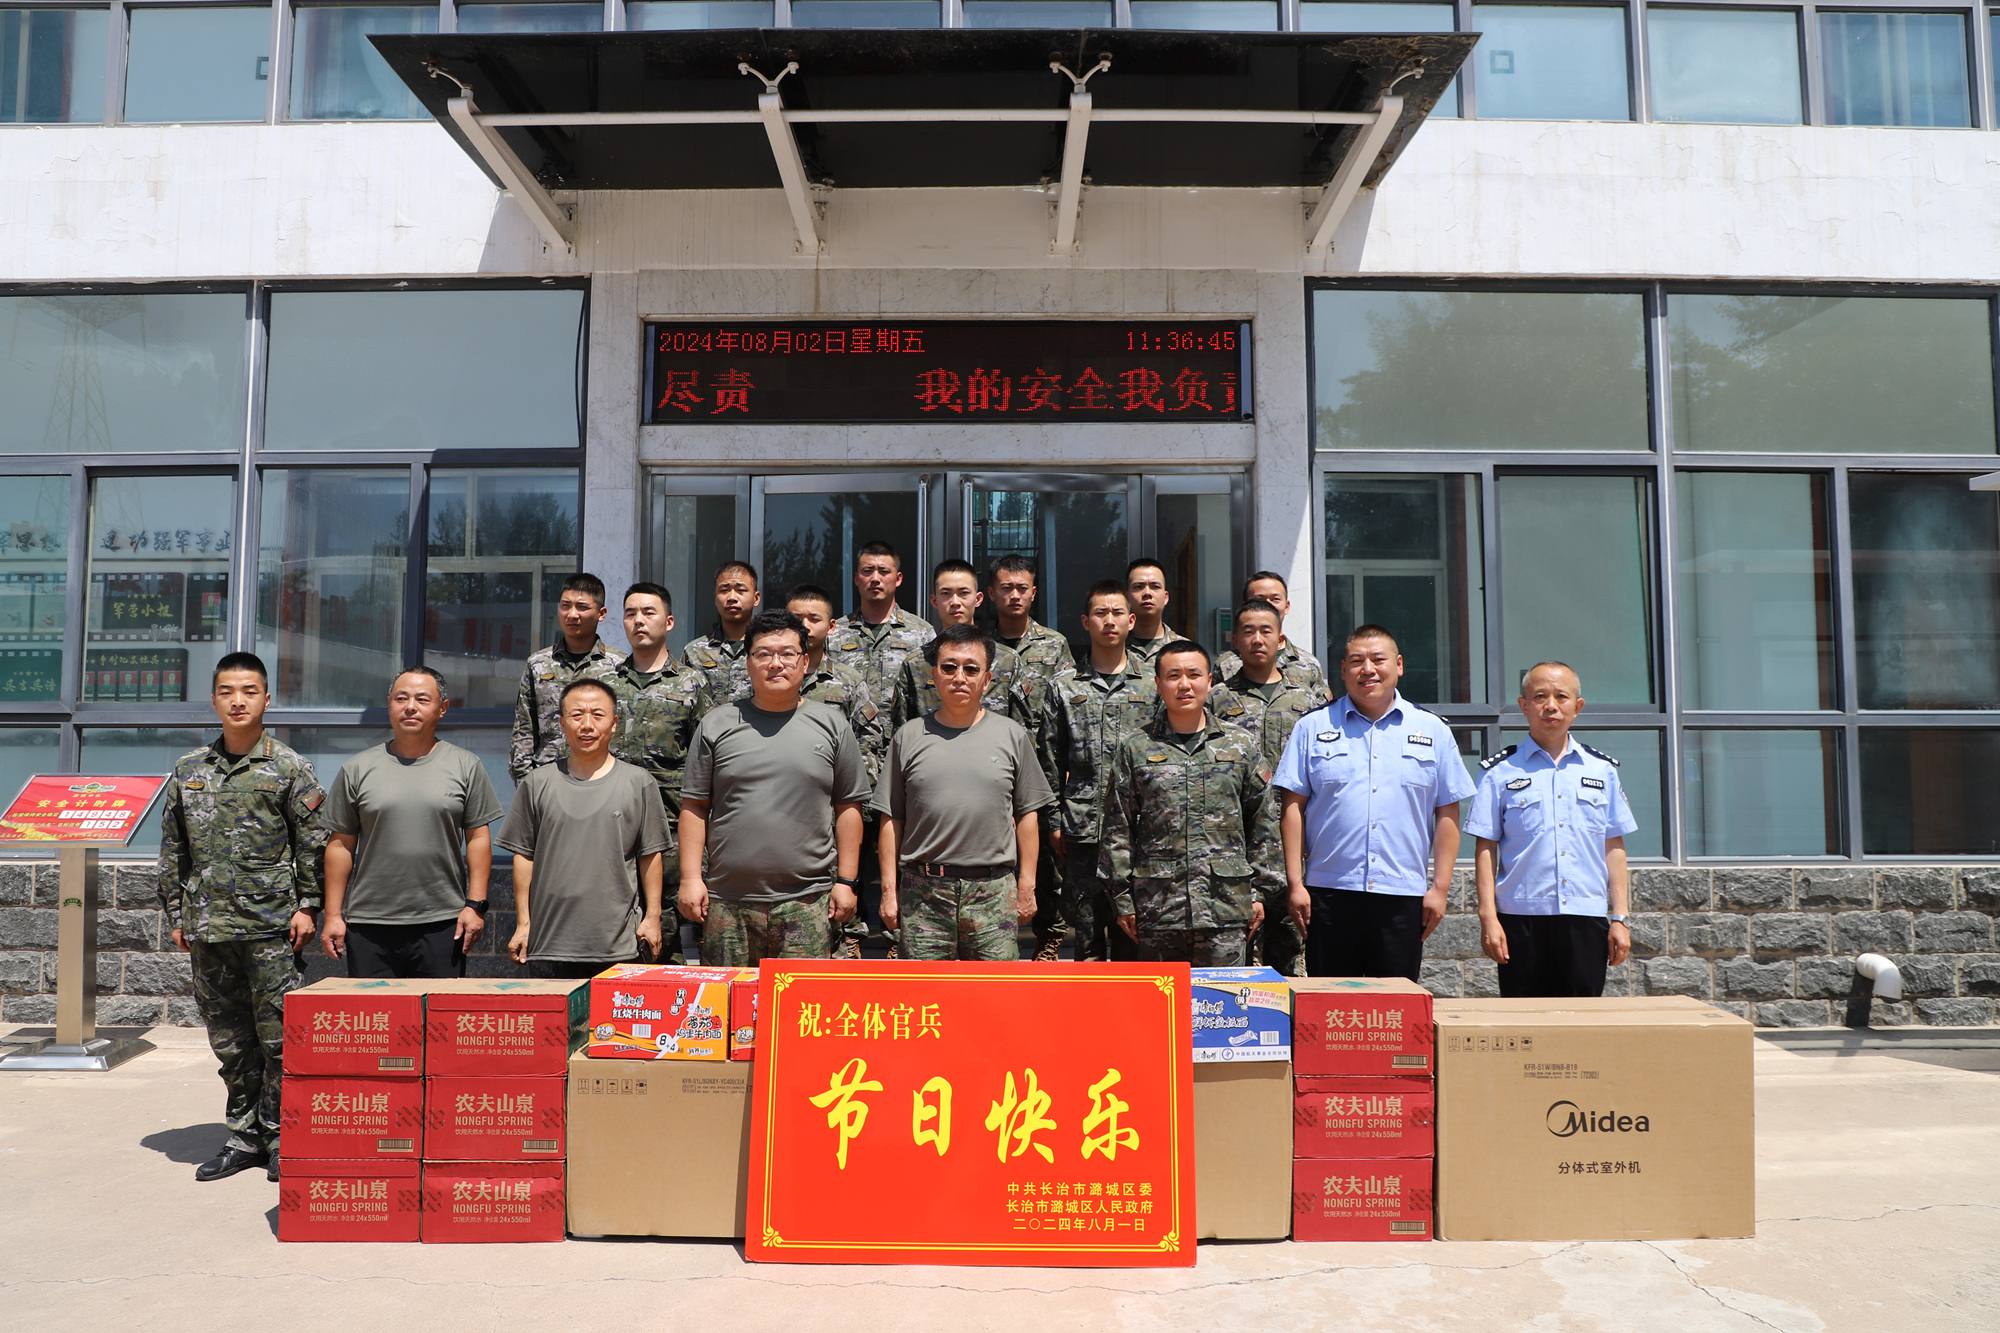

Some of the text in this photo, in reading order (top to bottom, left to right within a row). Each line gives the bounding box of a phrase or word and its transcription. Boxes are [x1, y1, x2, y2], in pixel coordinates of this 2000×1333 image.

[659, 328, 926, 354] 2024年08月02日星期五
[1126, 331, 1236, 351] 11:36:45
[658, 368, 755, 414] 尽责
[36, 799, 127, 808] 安全计时牌
[313, 1011, 389, 1031] 农夫山泉
[612, 1008, 662, 1021] 红烧牛肉面
[687, 1016, 712, 1028] 番茄
[1326, 1010, 1402, 1029] 农夫山泉
[456, 1014, 534, 1034] 农夫山泉
[313, 1034, 389, 1043] NONGFU SPRING
[456, 1037, 534, 1046] NONGFU SPRING
[1326, 1032, 1362, 1042] NONGFU
[1367, 1032, 1401, 1042] SPRING
[311, 1092, 388, 1112] 农夫山泉
[455, 1094, 534, 1114] 农夫山泉
[1326, 1096, 1402, 1116] 农夫山泉
[311, 1115, 388, 1125] NONGFU SPRING
[808, 1057, 1140, 1170] 节日快乐
[1548, 1104, 1650, 1136] Midea
[455, 1117, 533, 1126] NONGFU SPRING
[1326, 1119, 1401, 1128] NONGFU SPRING
[1558, 1161, 1641, 1174] 分体式室外机
[309, 1180, 387, 1200] 农夫山泉
[453, 1181, 531, 1201] 农夫山泉
[1006, 1182, 1153, 1196] 中共长治市潞城区委
[1323, 1176, 1401, 1195] 农夫山泉
[309, 1203, 387, 1212] NONGFU SPRING
[453, 1204, 530, 1214] NONGFU SPRING
[1005, 1199, 1154, 1214] 长治市潞城区人民政府
[1323, 1199, 1400, 1208] NONGFU SPRING
